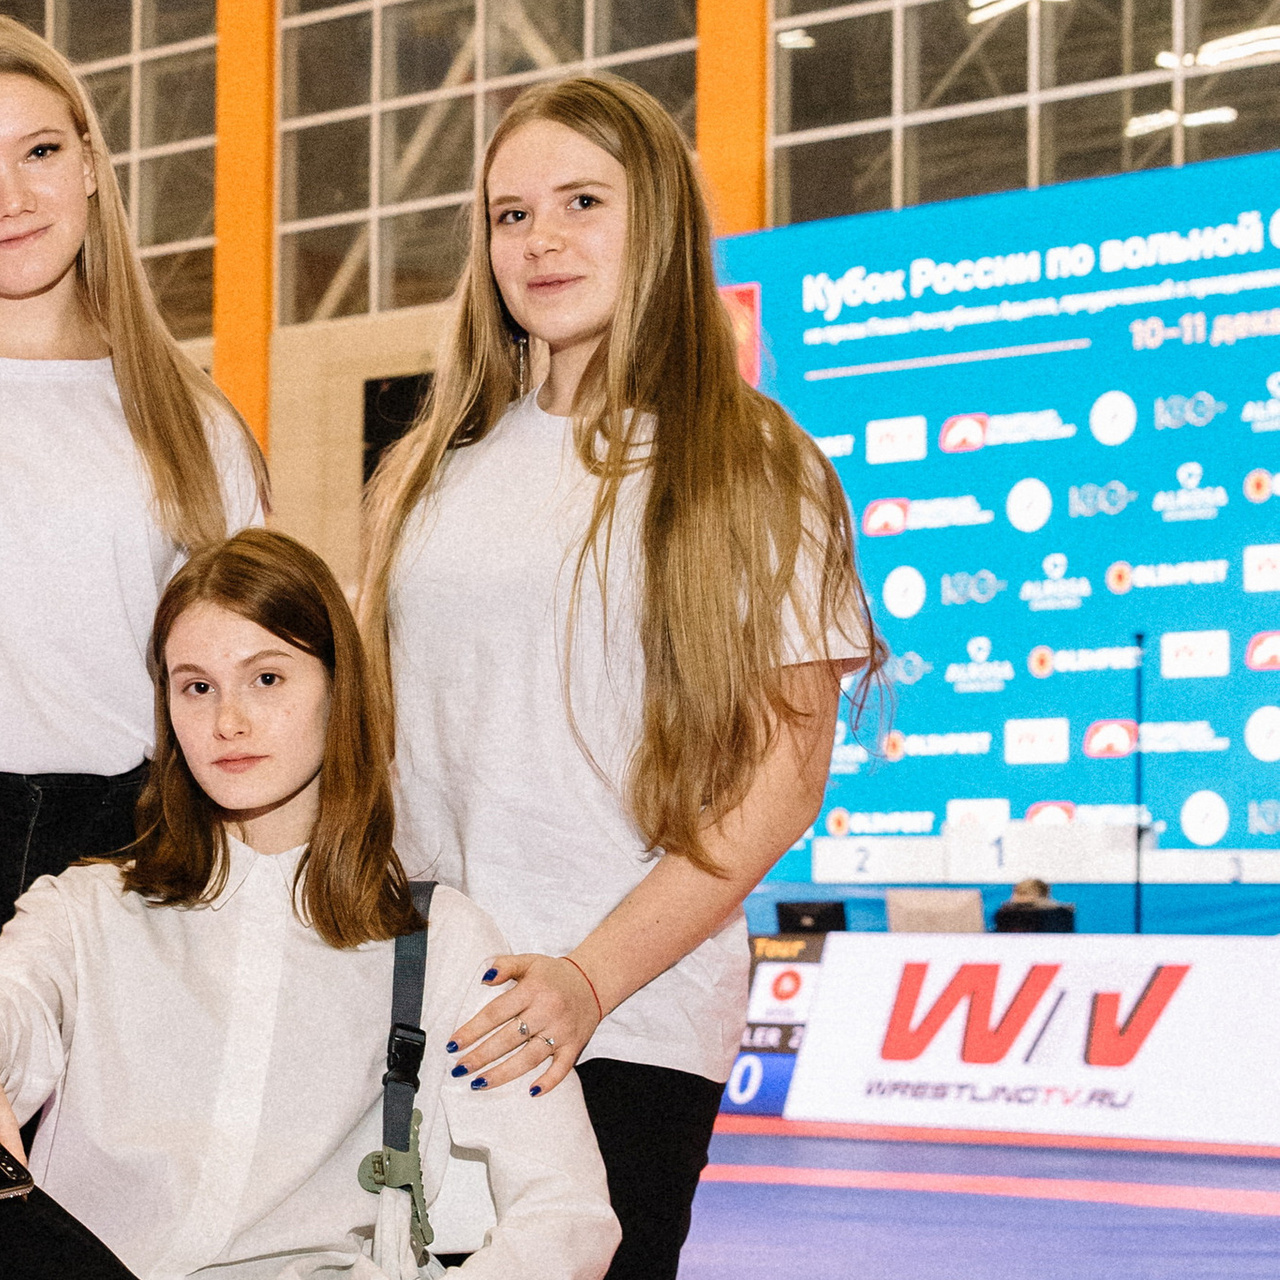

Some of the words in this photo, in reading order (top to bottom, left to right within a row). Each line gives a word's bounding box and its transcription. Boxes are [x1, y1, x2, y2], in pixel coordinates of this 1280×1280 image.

[802, 266, 906, 321] Кубок
[910, 250, 1041, 298] России
[1045, 243, 1095, 280] по
[1099, 210, 1264, 273] вольной
[856, 846, 869, 872] 2
[990, 836, 1004, 867] 1
